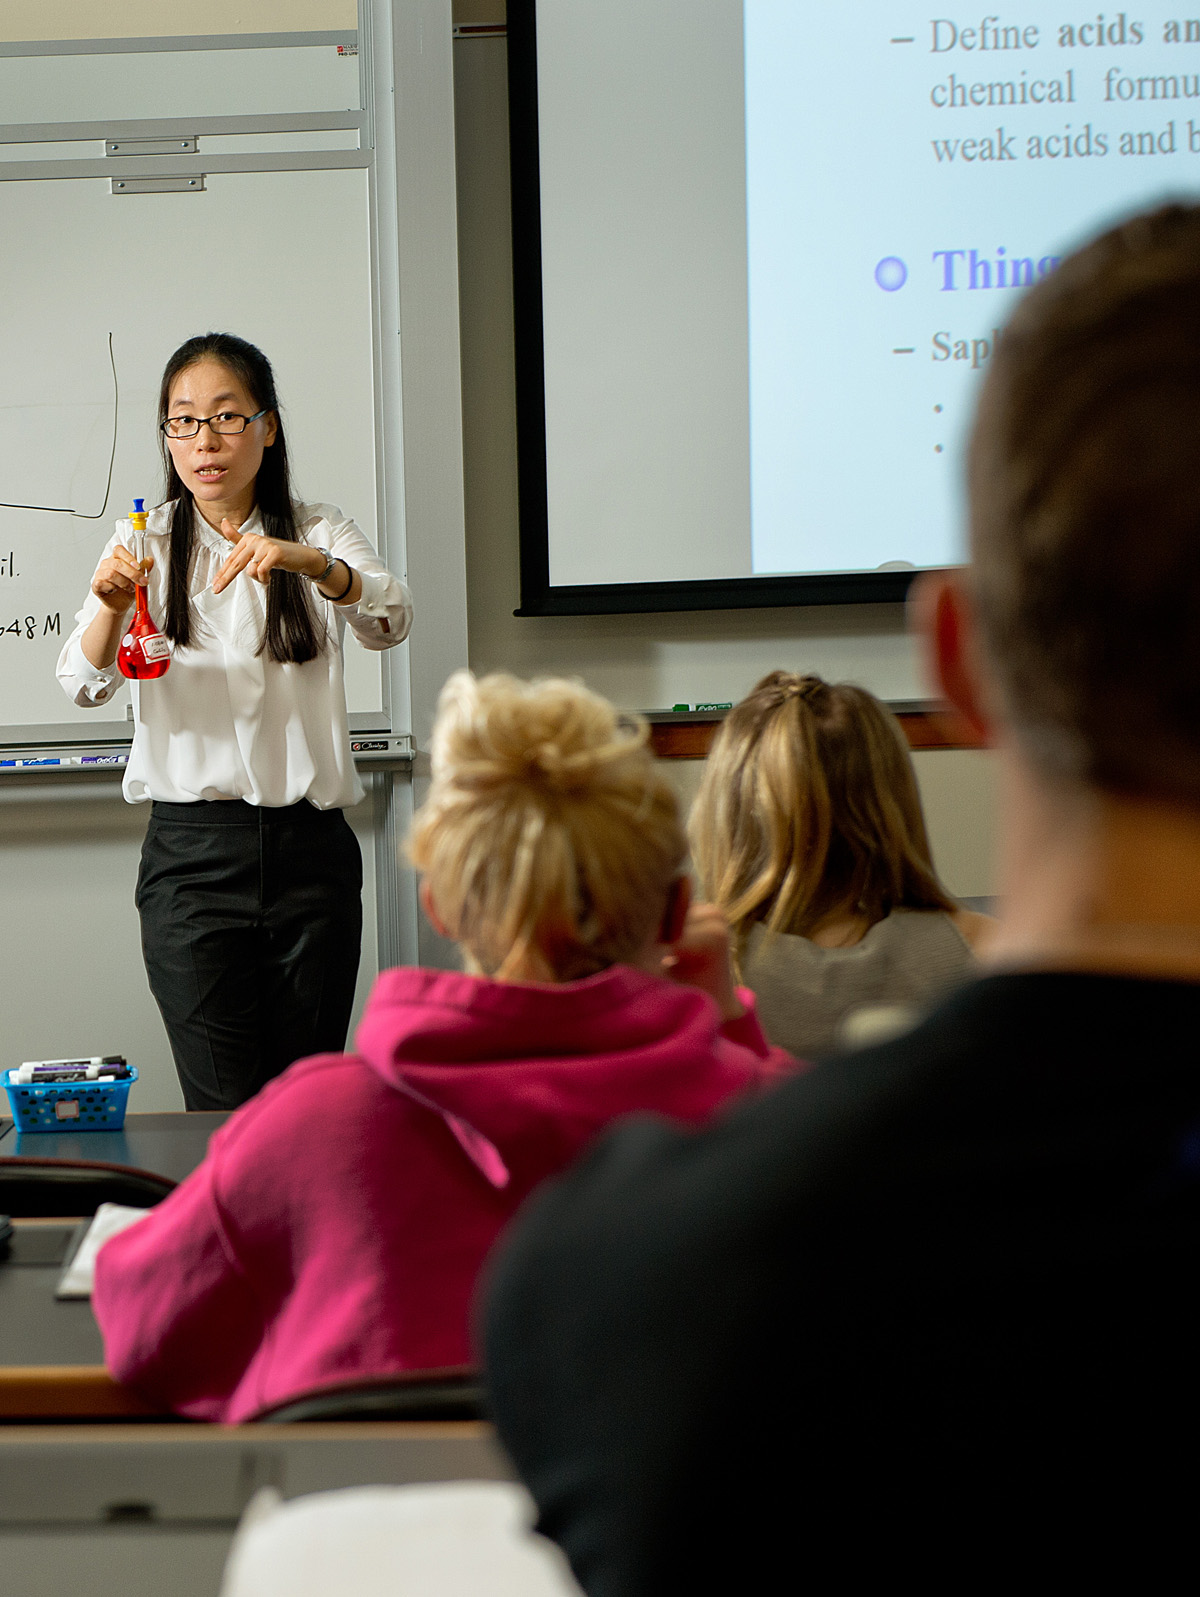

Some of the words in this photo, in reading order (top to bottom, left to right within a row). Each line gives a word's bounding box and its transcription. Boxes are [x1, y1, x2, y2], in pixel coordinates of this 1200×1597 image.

[929, 15, 1040, 53] Define
[1058, 12, 1144, 47] acids
[930, 69, 1076, 108] chemical
[931, 126, 1017, 163] weak
[1026, 123, 1109, 159] acids
[1119, 119, 1178, 156] and
